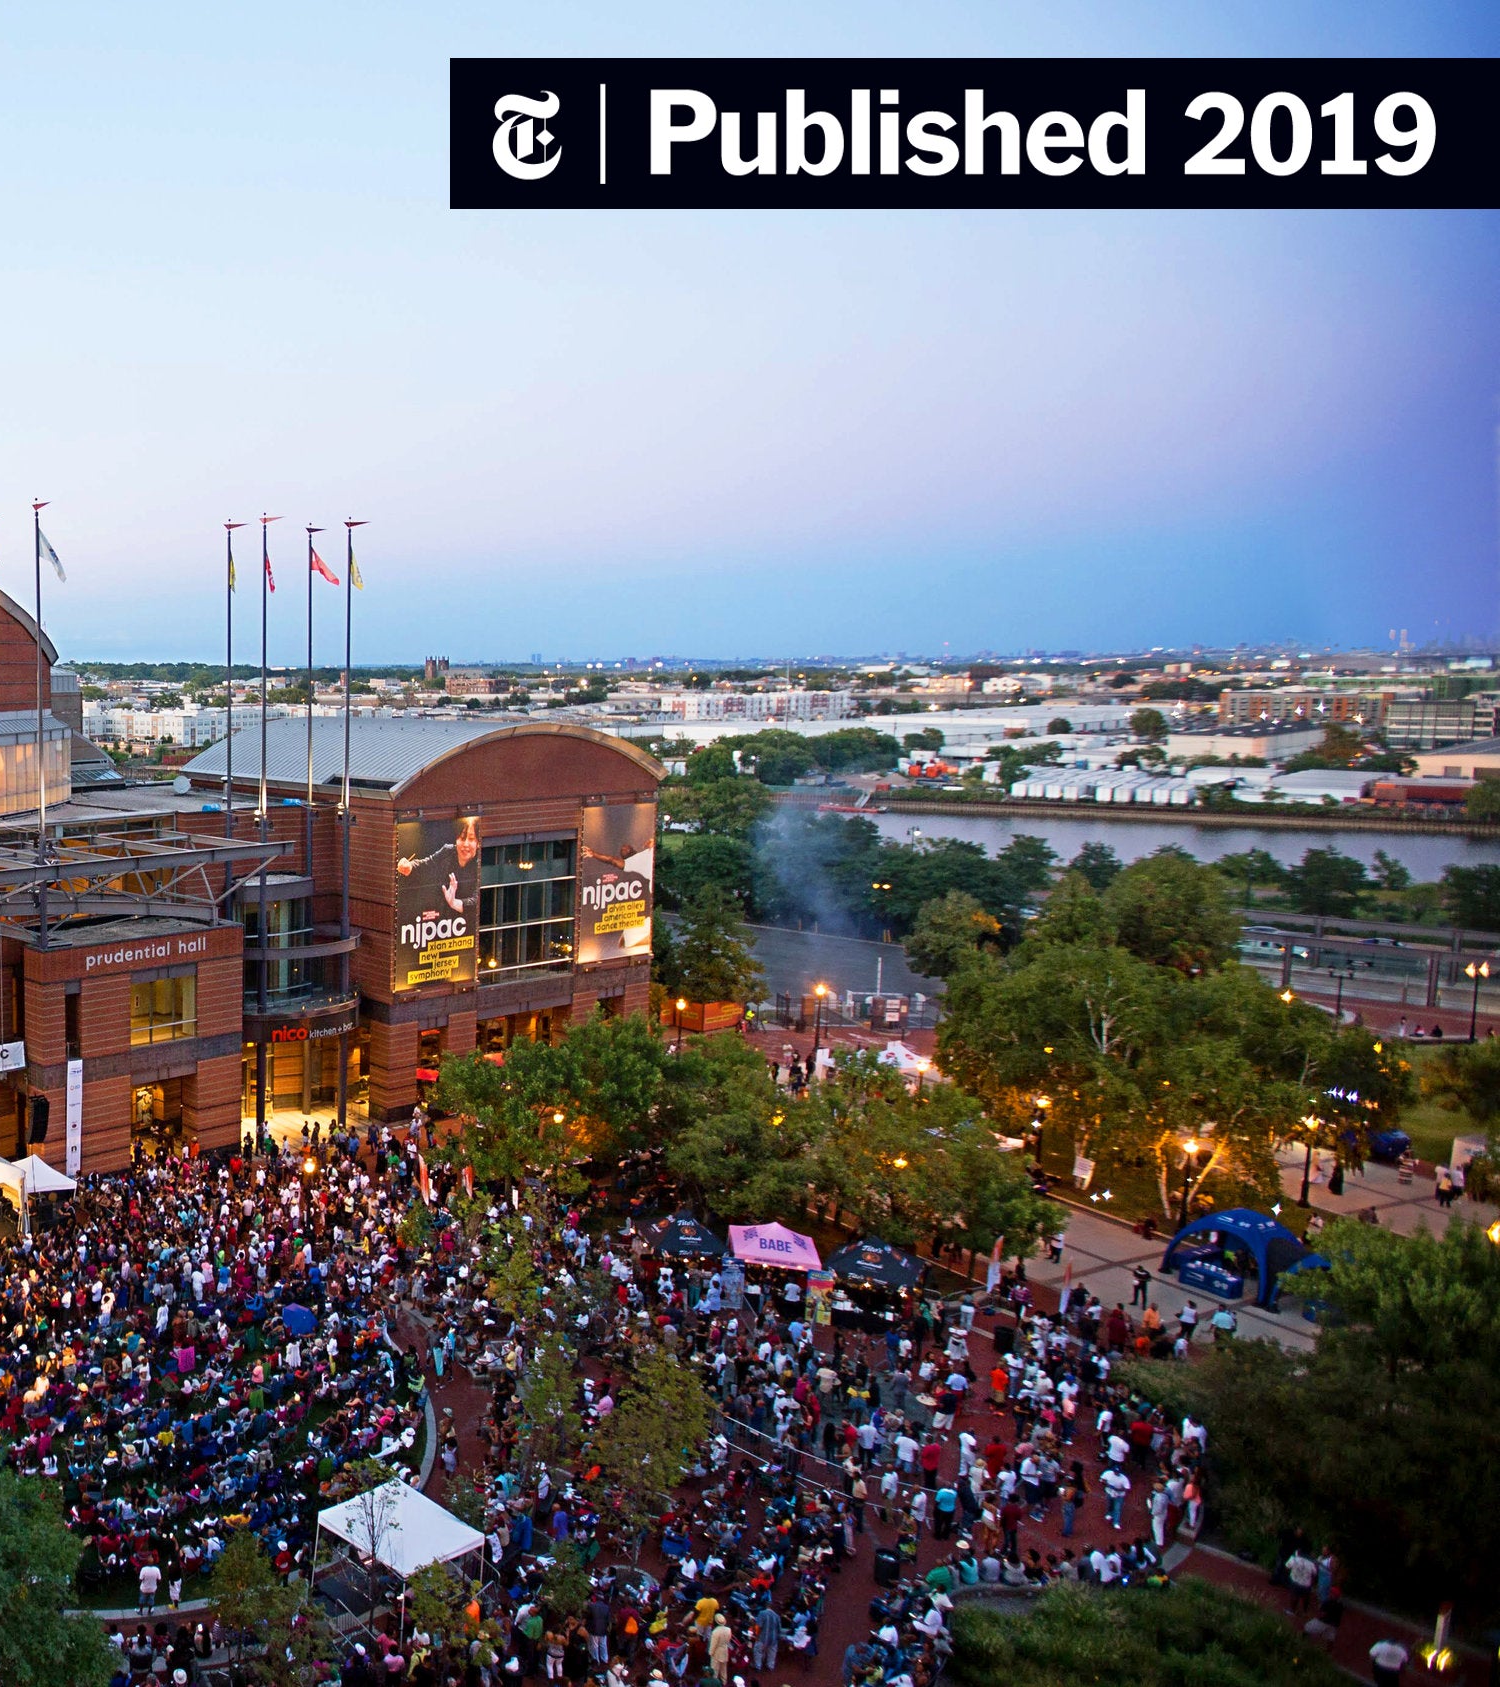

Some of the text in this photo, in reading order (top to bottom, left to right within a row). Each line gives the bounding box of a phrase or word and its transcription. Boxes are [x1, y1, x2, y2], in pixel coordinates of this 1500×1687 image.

[583, 878, 643, 910] njpac
[603, 911, 636, 922] american
[596, 918, 644, 931] dance theater
[401, 916, 467, 949] njpac
[429, 937, 472, 951] xian zhang
[85, 937, 207, 971] prudential hall
[421, 952, 438, 961] new
[409, 967, 450, 980] symphony
[271, 1025, 308, 1042] nico
[309, 1027, 337, 1039] kitchen
[343, 1022, 354, 1032] bar
[759, 1238, 793, 1253] BABE
